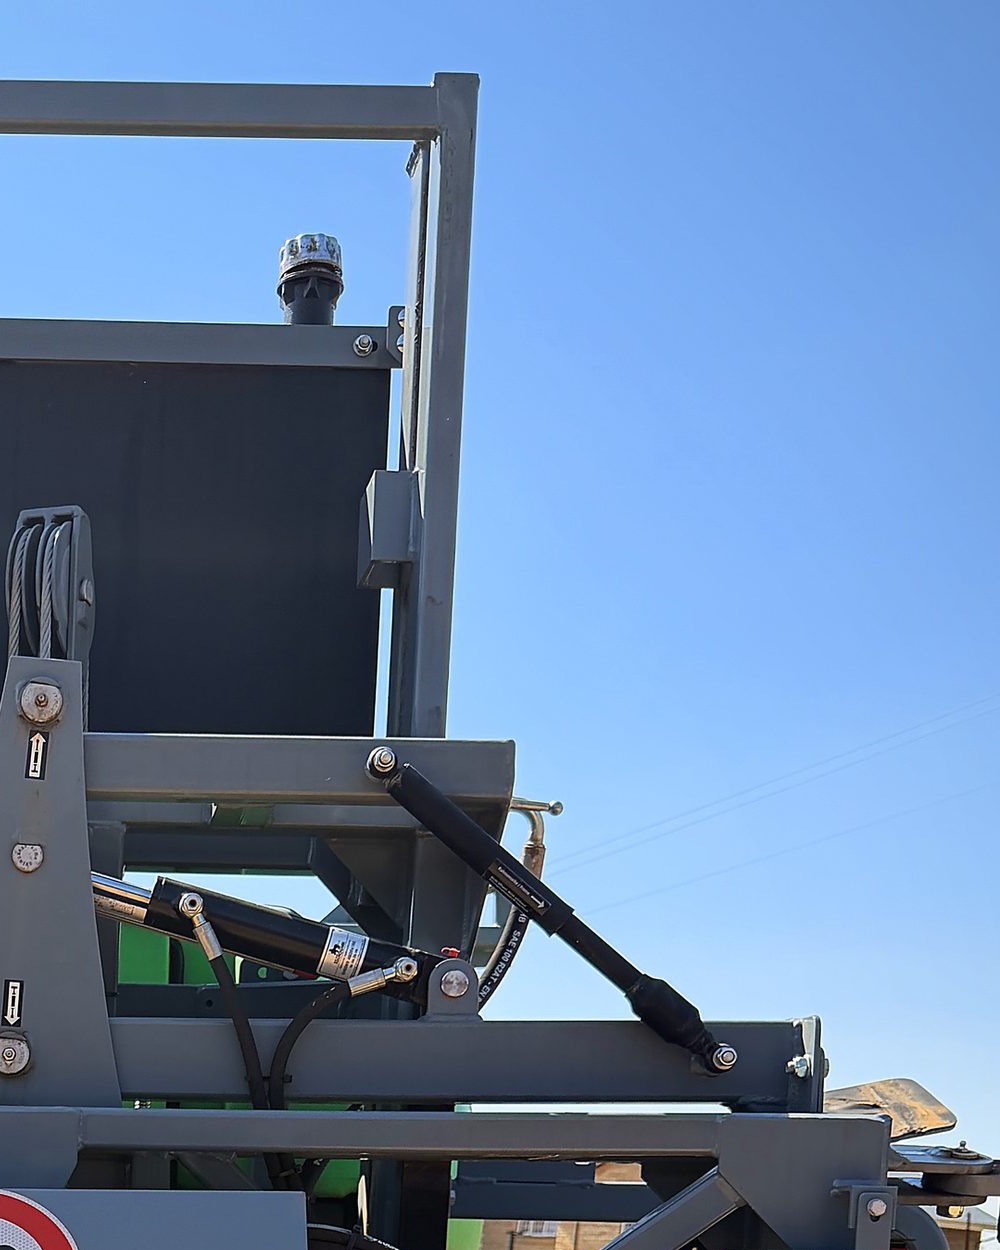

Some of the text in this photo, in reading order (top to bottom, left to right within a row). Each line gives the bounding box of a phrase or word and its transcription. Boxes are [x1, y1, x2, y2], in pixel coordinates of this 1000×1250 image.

[508, 929, 521, 949] SAE
[501, 948, 512, 963] 100
[490, 961, 506, 984] R2AT
[479, 985, 491, 998] EN
